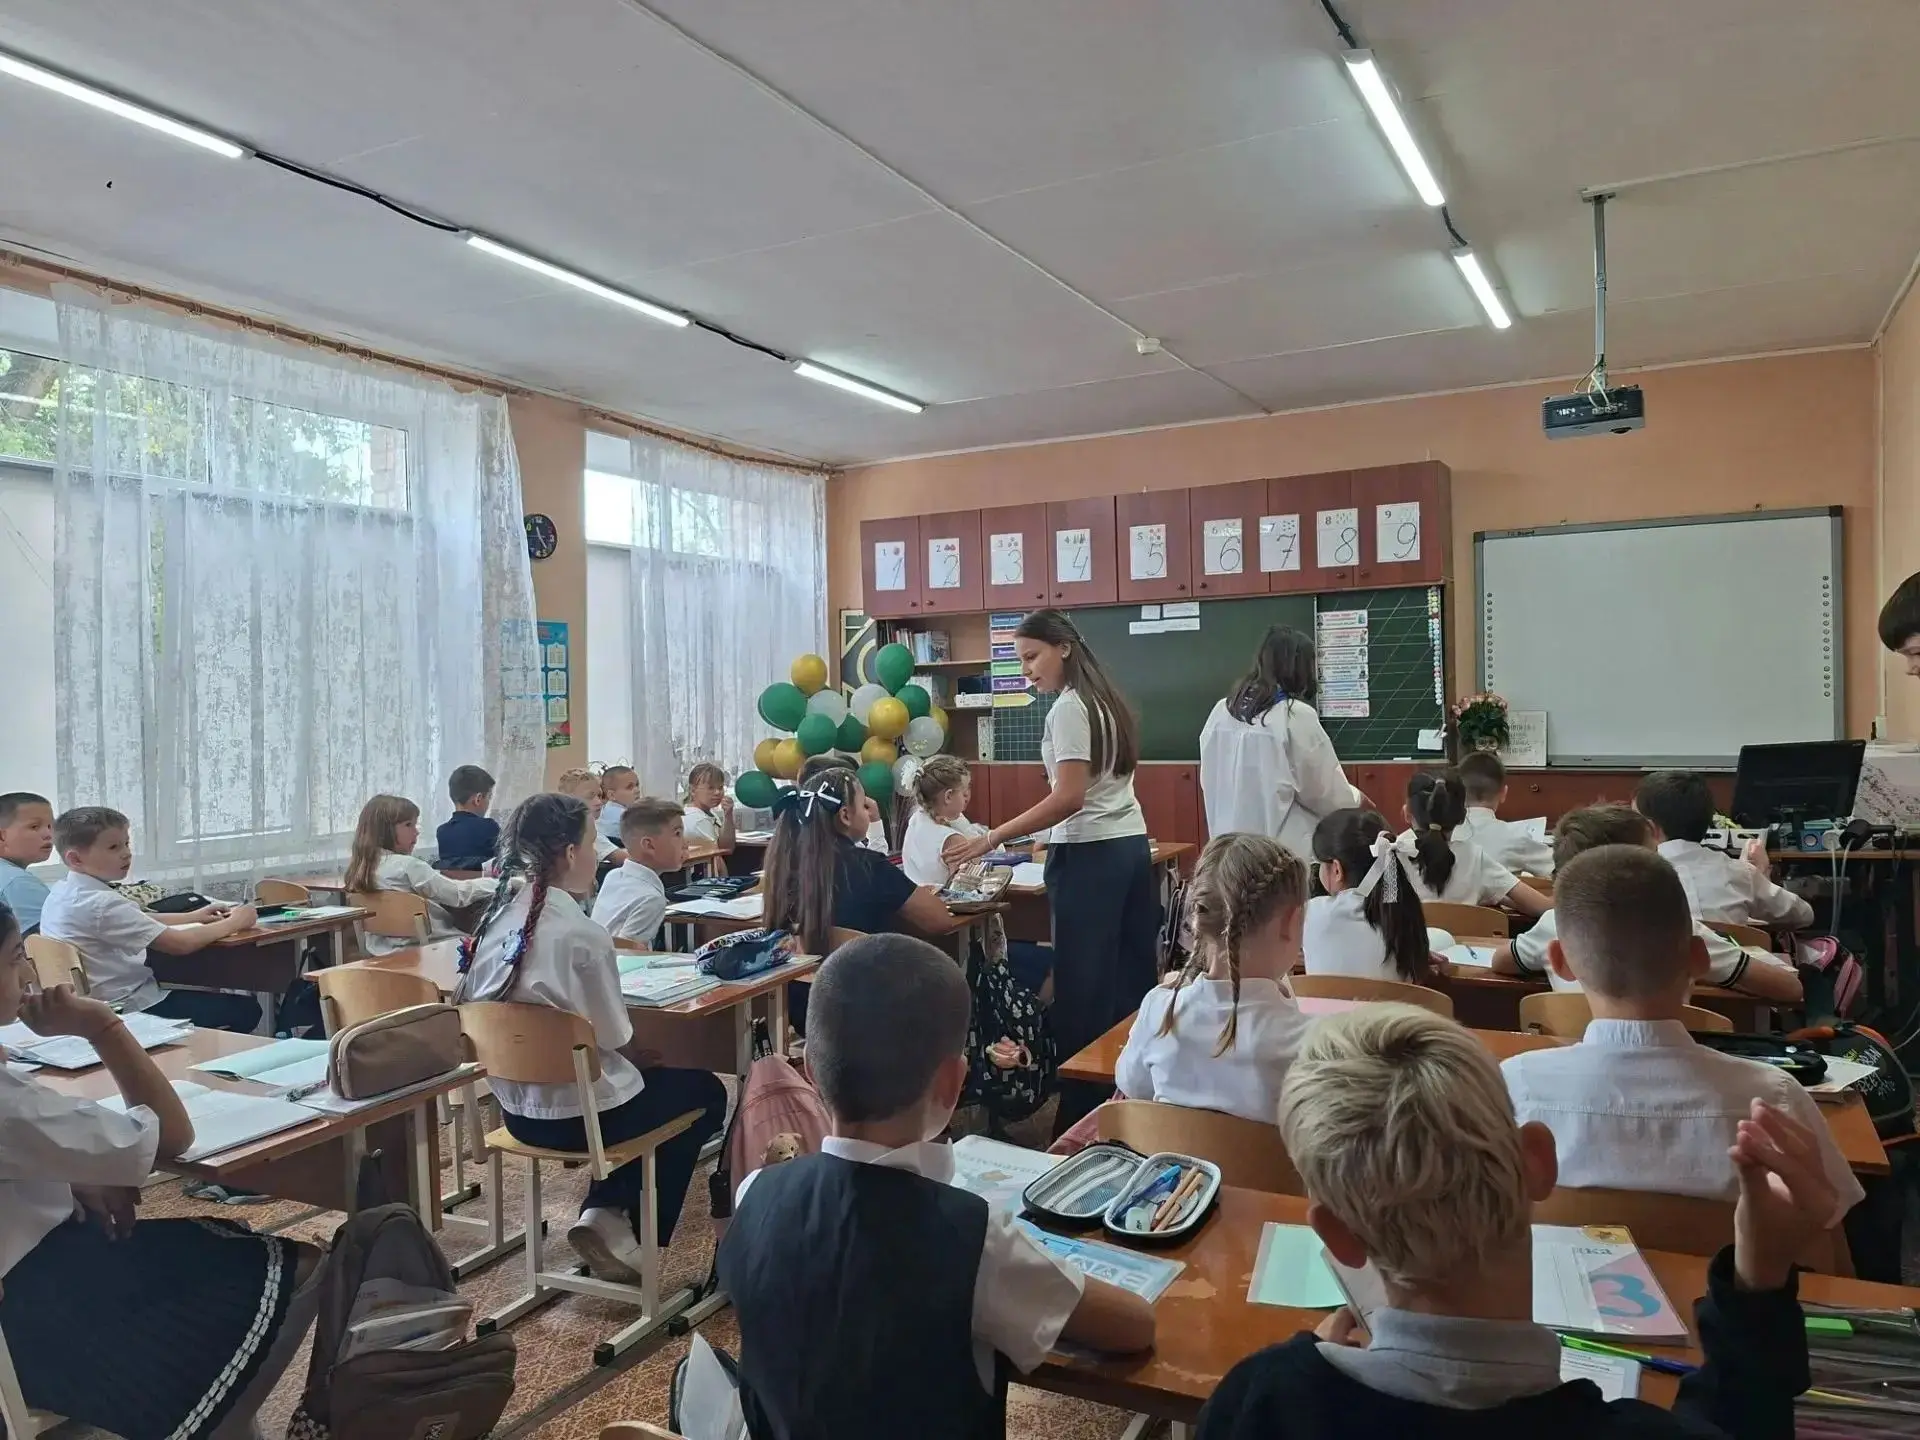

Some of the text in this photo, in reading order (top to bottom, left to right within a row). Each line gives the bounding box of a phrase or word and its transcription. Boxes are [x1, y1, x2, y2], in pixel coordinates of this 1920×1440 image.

[1326, 516, 1332, 525] 8
[1385, 510, 1391, 518] 9
[936, 544, 941, 553] 2
[1137, 532, 1143, 540] 5
[1277, 533, 1297, 568] 7
[1335, 527, 1357, 563] 8
[1393, 522, 1417, 558] 9
[1005, 549, 1022, 581] 3
[1072, 546, 1088, 579] 4
[1146, 542, 1163, 576] 5
[1220, 536, 1240, 571] 6
[893, 557, 903, 588] 1
[943, 554, 960, 586] 2
